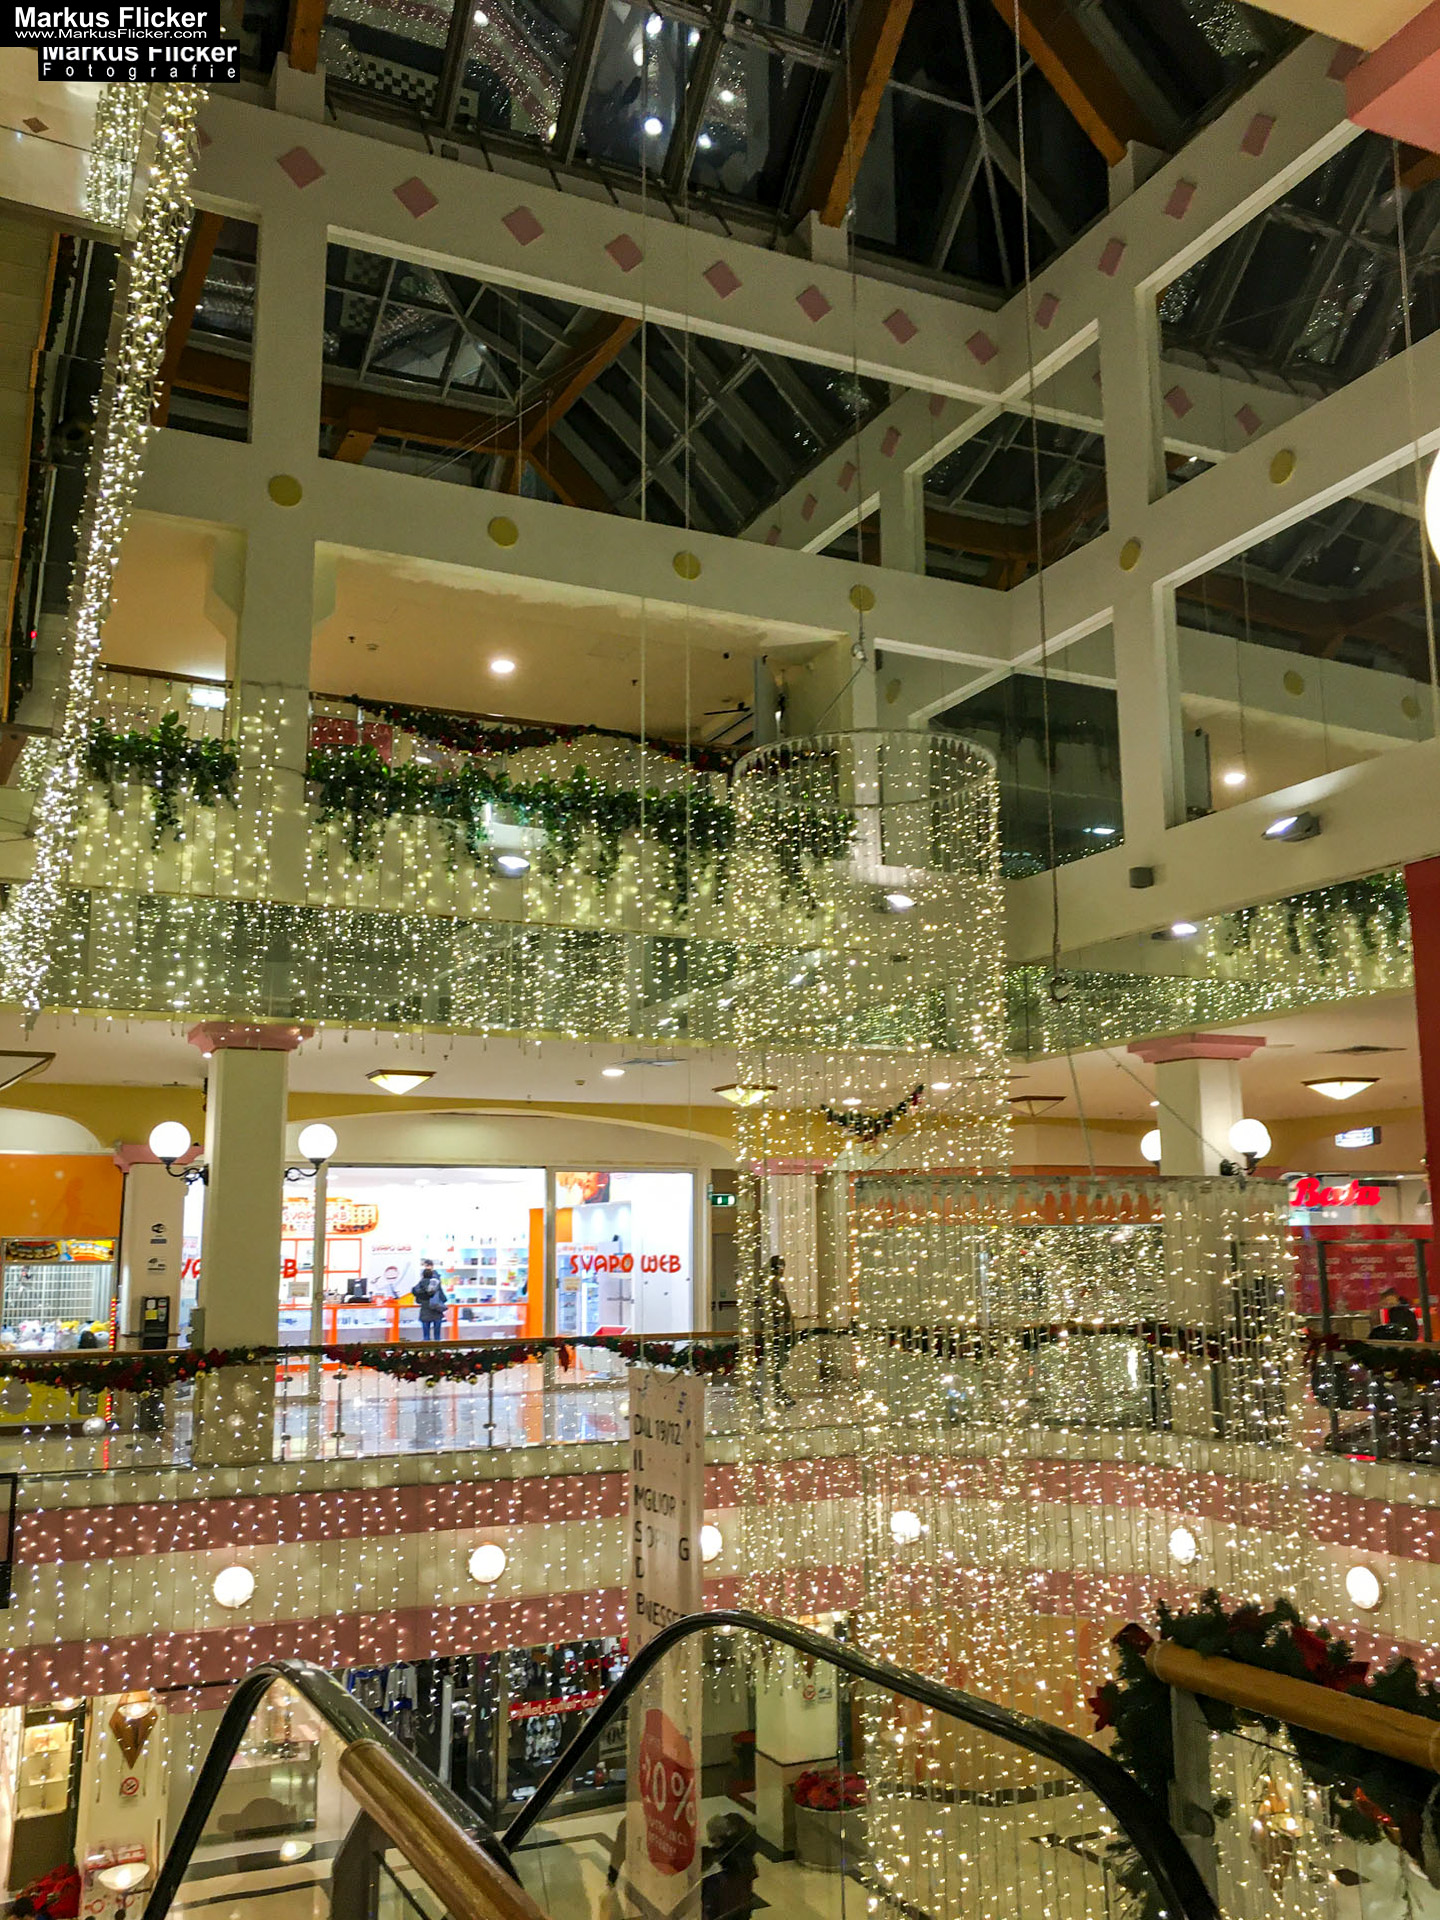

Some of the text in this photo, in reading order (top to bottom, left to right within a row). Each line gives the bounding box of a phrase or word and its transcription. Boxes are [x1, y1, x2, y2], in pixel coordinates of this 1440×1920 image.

[1290, 1177, 1381, 1207] Bata
[570, 1253, 681, 1274] SVAPO WEB
